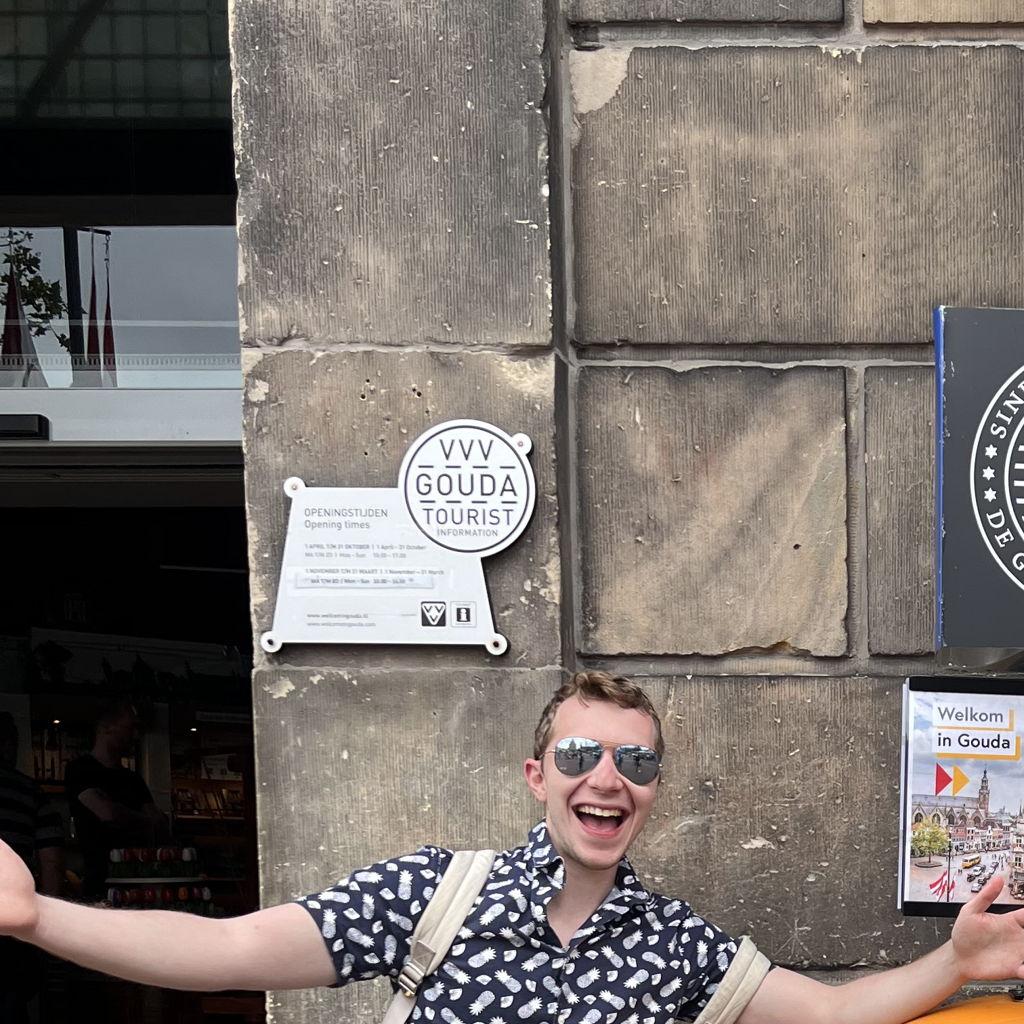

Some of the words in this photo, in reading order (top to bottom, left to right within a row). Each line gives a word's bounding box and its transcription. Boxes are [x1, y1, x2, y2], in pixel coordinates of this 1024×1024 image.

[439, 439, 494, 461] VVV
[416, 473, 518, 496] GOUDA
[304, 519, 343, 531] Opening
[344, 519, 370, 529] times
[422, 508, 514, 526] TOURIST
[436, 528, 498, 537] INFORMATION
[987, 508, 1015, 547] DE
[937, 706, 1004, 723] Welkom
[937, 732, 952, 747] in
[957, 733, 1011, 749] Gouda
